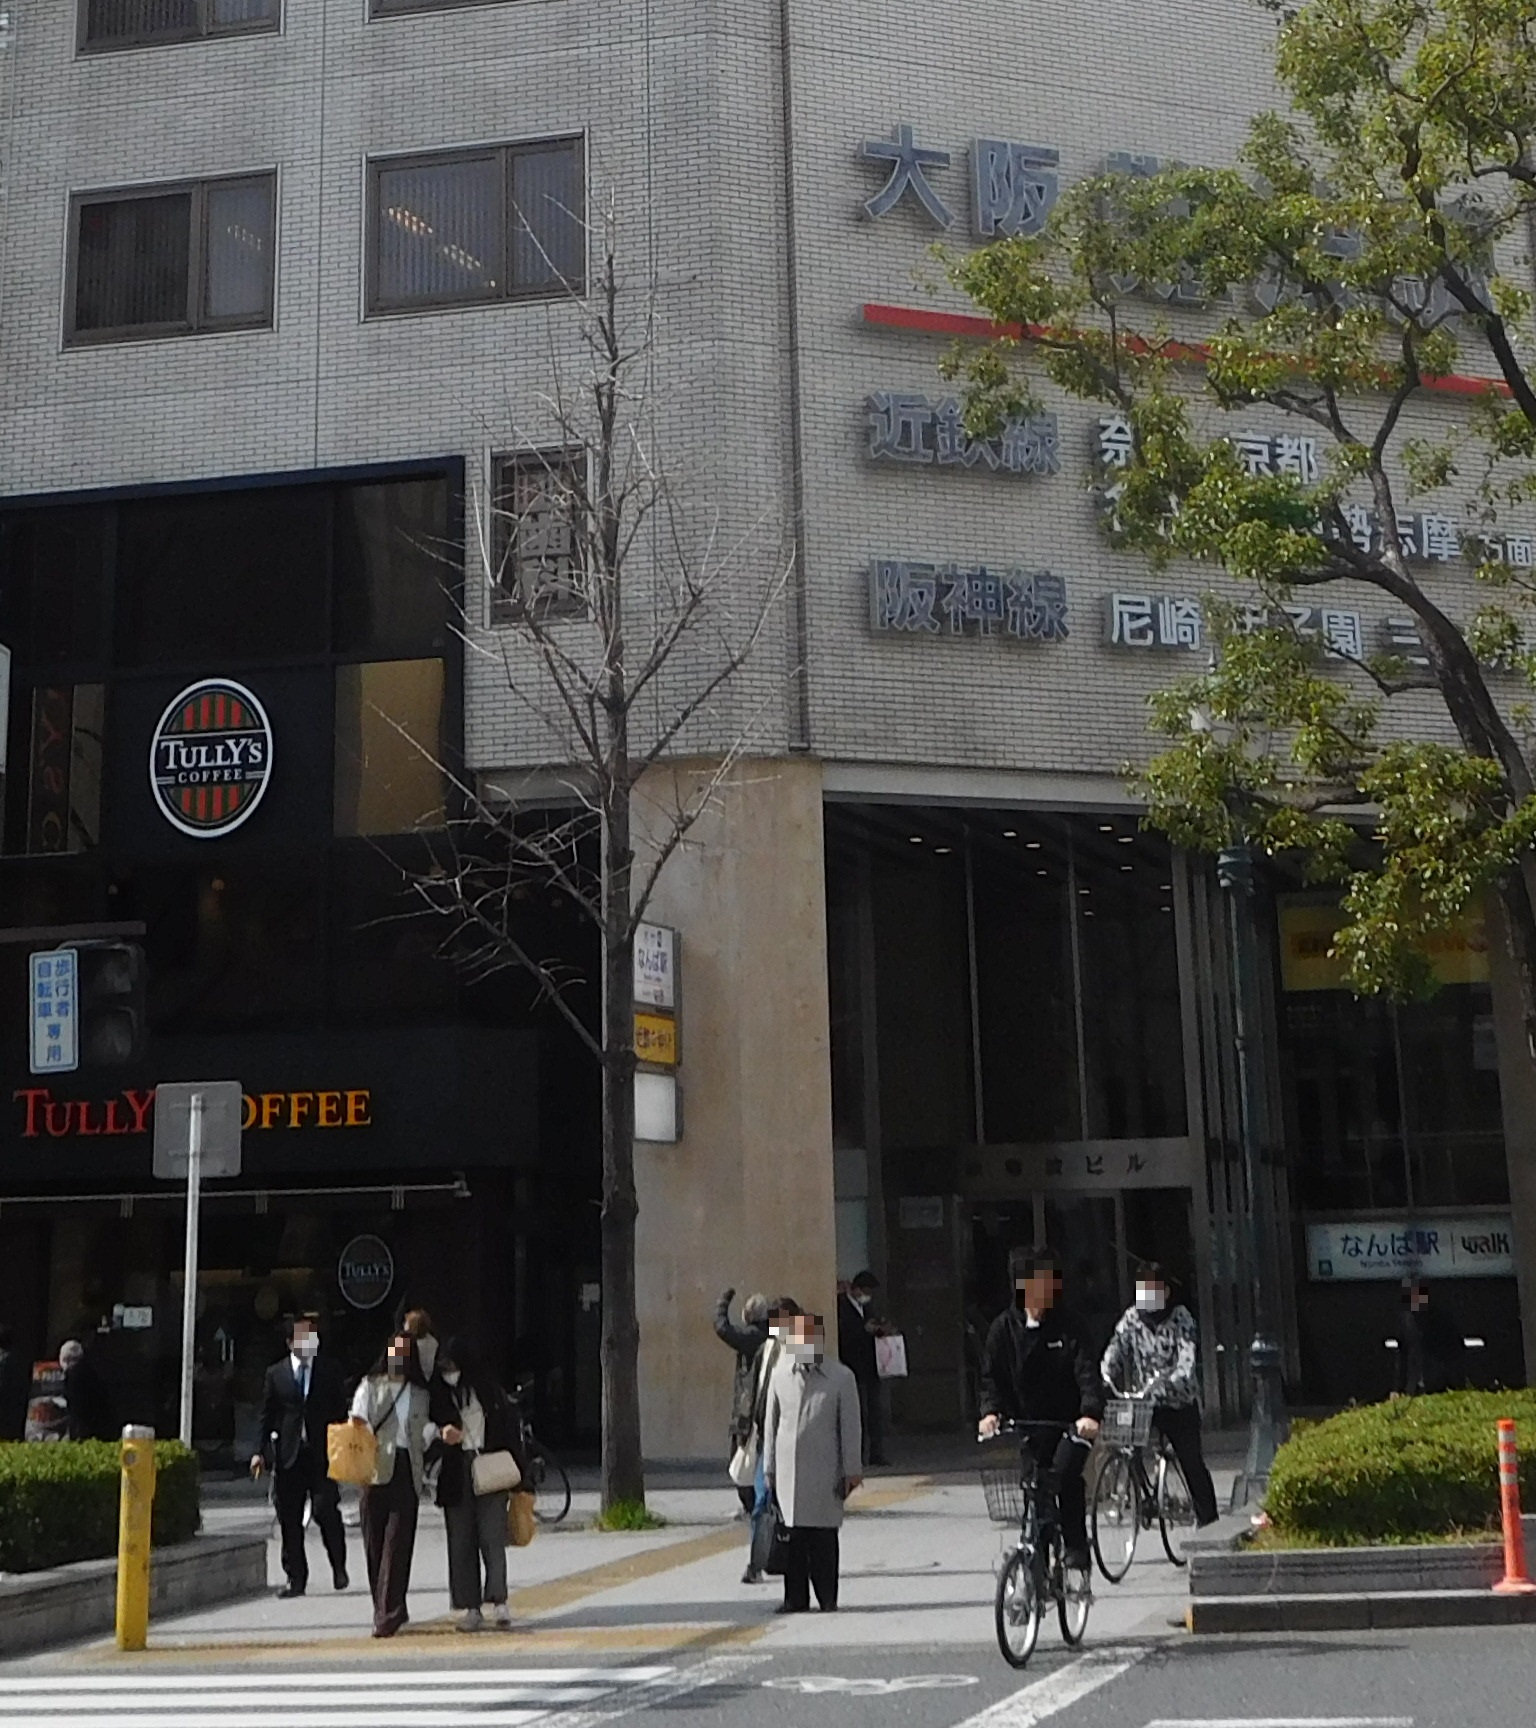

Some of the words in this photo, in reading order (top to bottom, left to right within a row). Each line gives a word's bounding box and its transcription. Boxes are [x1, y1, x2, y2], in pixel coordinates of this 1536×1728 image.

[1234, 430, 1320, 484] 京都
[870, 560, 1071, 642] 阪神線
[1110, 592, 1203, 652] 尼崎
[161, 738, 263, 770] TULLY'S
[177, 768, 244, 784] COFFEE
[13, 1089, 158, 1138] TULLY
[1340, 1230, 1440, 1258] なんば駅
